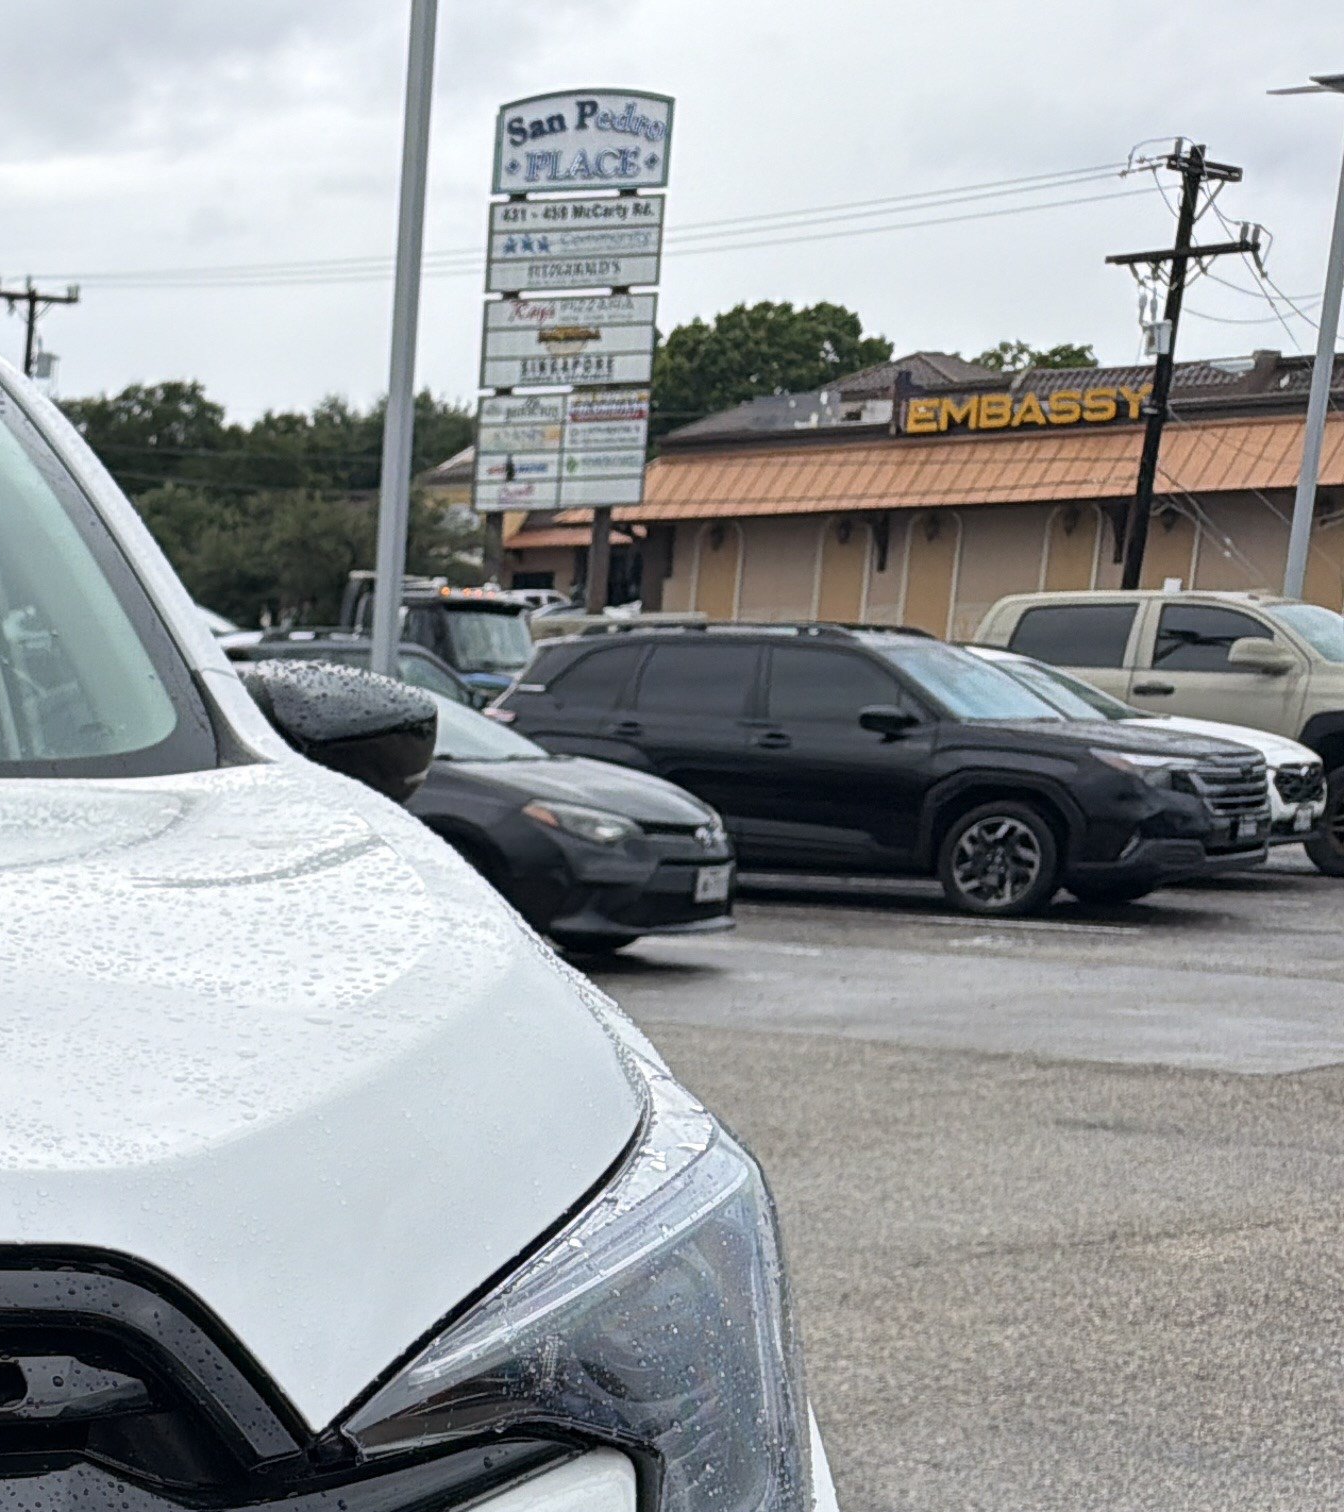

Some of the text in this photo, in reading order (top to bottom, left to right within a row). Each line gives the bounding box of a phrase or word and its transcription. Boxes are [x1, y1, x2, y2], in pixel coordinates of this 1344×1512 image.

[507, 100, 667, 147] San Pedro
[525, 146, 642, 182] PLACE
[572, 203, 628, 221] McCarty
[907, 384, 1153, 434] EMBASSY
